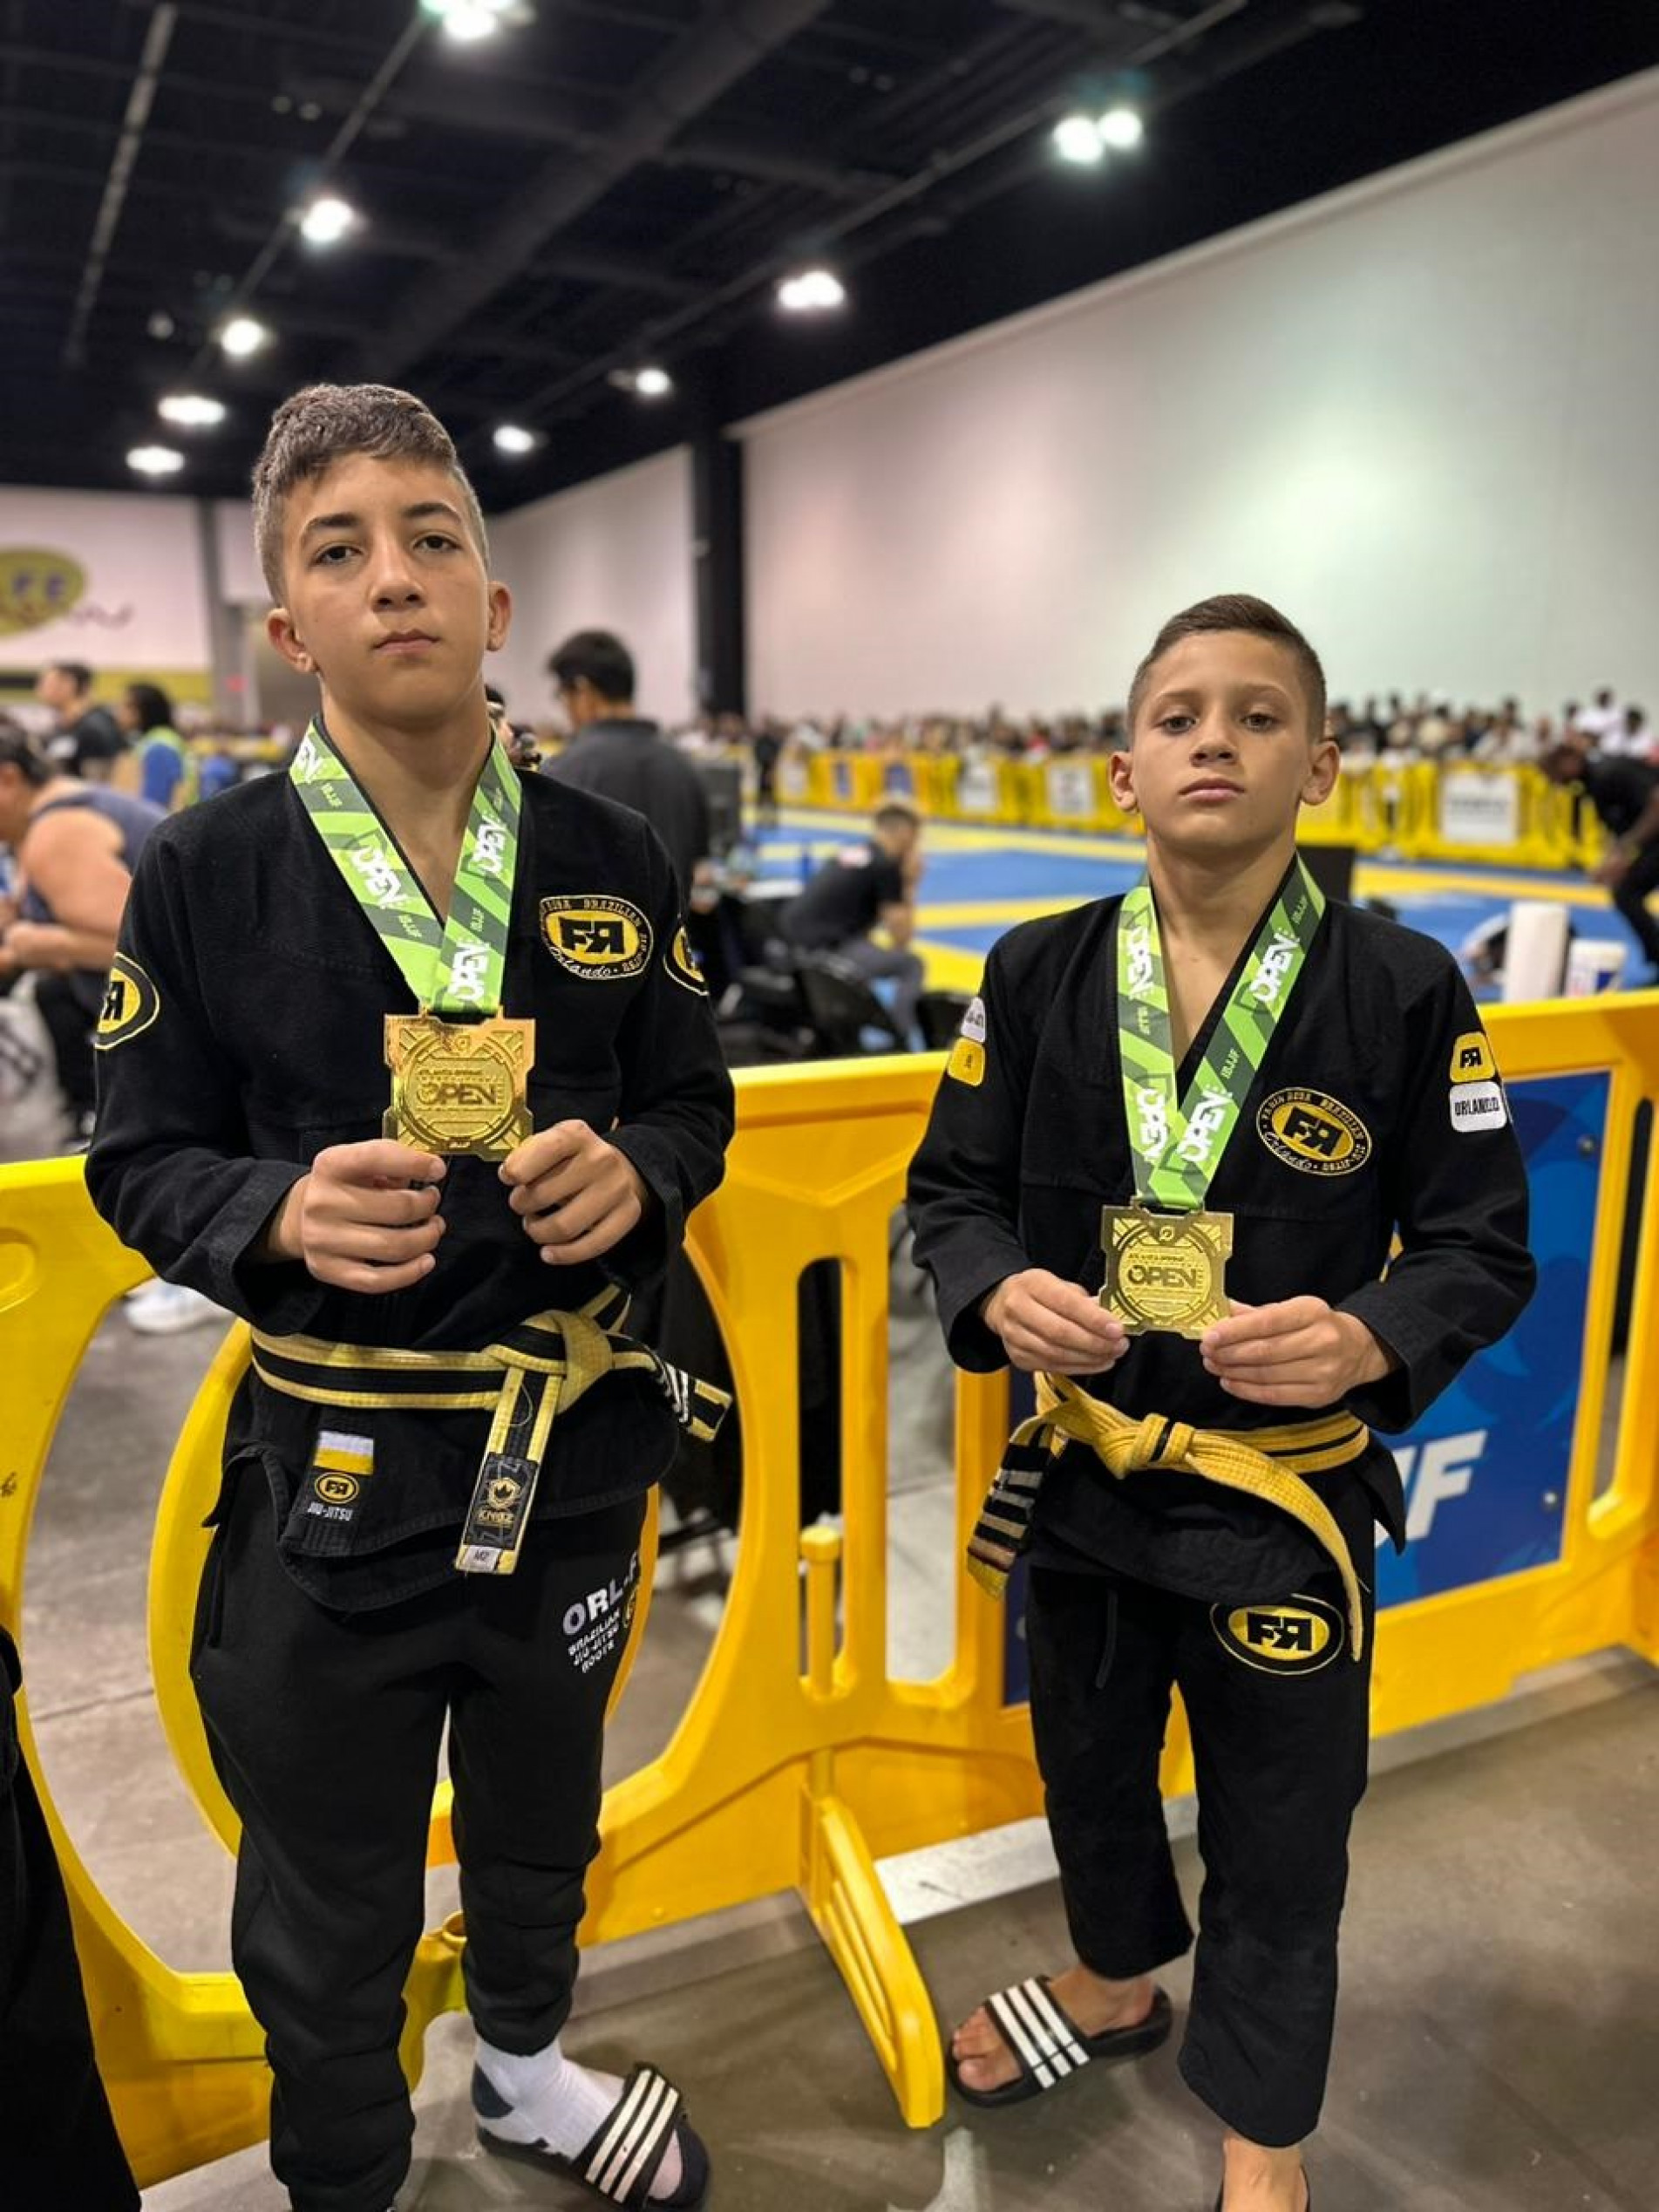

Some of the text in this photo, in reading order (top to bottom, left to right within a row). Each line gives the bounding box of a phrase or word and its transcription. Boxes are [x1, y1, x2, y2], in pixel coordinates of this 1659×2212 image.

[1249, 932, 1301, 1003] OPEN
[415, 1081, 498, 1106] OPEN
[1454, 1096, 1500, 1117] ORLANDO
[1175, 1089, 1233, 1162] OPEN
[1127, 1264, 1197, 1289] OPEN
